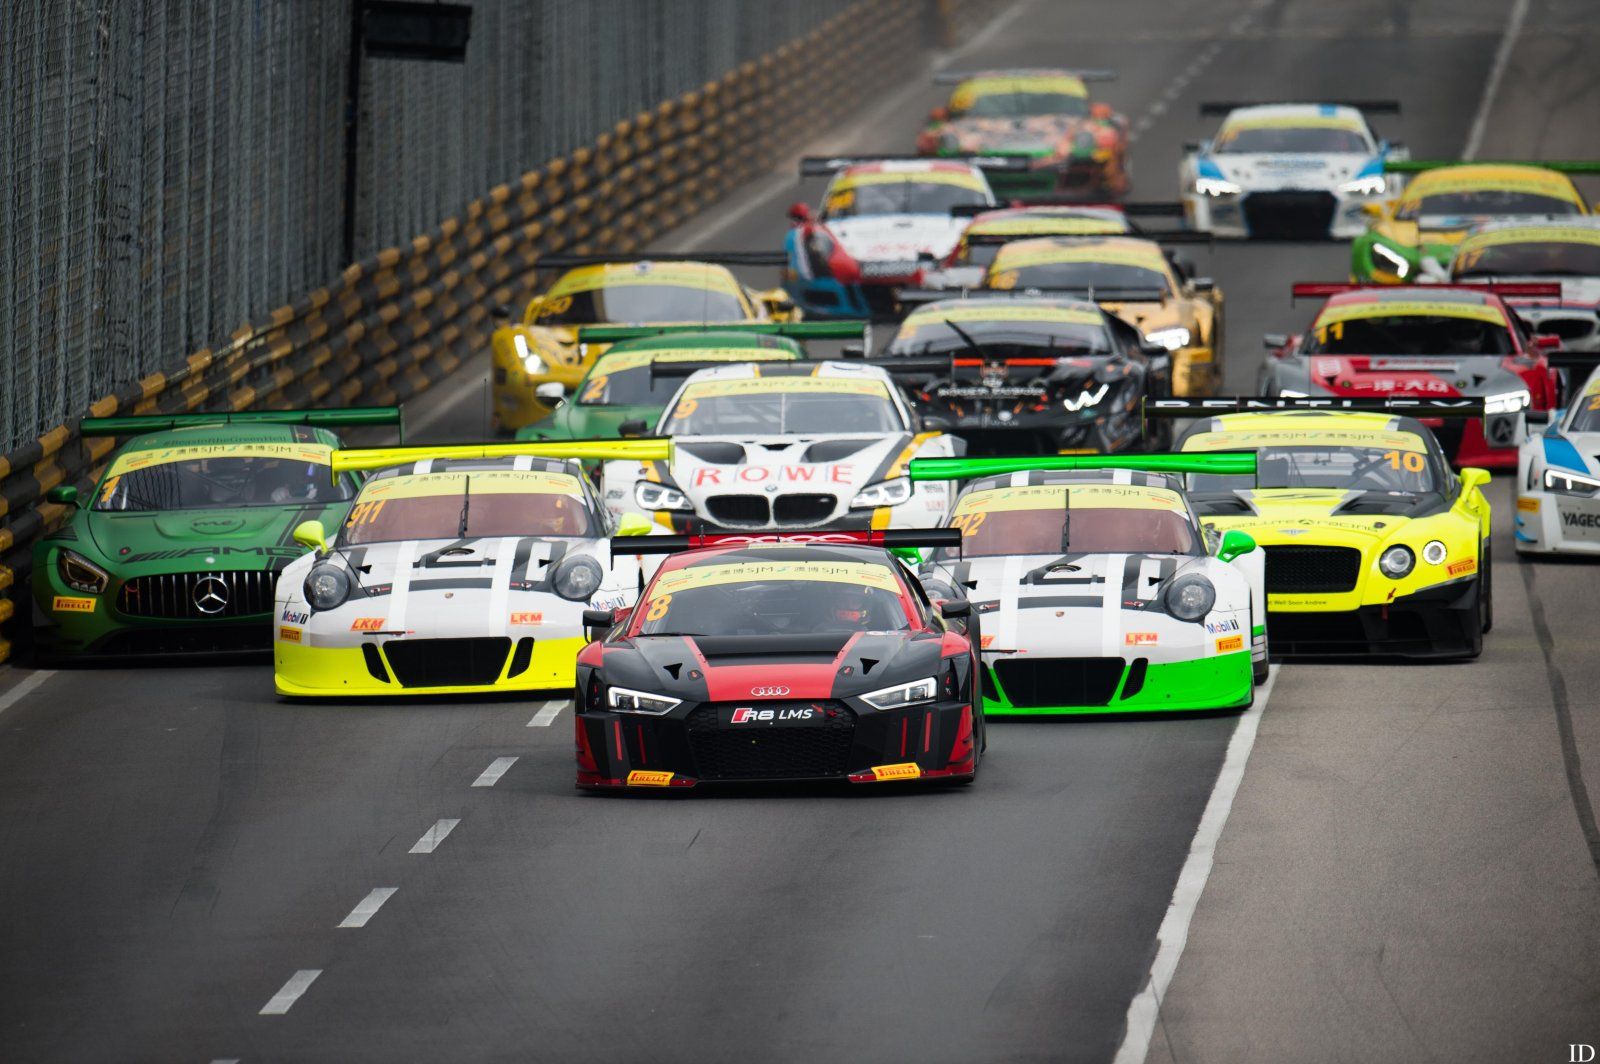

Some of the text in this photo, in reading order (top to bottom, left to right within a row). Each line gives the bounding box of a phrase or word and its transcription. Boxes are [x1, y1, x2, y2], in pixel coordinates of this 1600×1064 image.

[1314, 322, 1343, 344] 11
[582, 376, 608, 401] 2
[673, 400, 698, 419] 9
[1383, 451, 1424, 472] 10
[694, 465, 855, 486] ROWE
[101, 477, 121, 502] 1
[346, 500, 386, 528] 911
[178, 547, 303, 558] AMG
[1448, 559, 1475, 575] PIRELLI
[56, 599, 92, 609] PIRELLI
[646, 594, 672, 622] 8
[282, 609, 301, 623] Mobil
[511, 613, 542, 623] LKM
[351, 618, 385, 630] LKM
[1206, 620, 1231, 634] Mobil
[281, 629, 300, 640] PIRELLI
[1125, 633, 1158, 643] LKM
[1219, 638, 1241, 650] PIRELLI
[738, 708, 814, 721] R8 LMS
[878, 764, 916, 777] PIRELLI
[630, 773, 668, 784] PIRELLI
